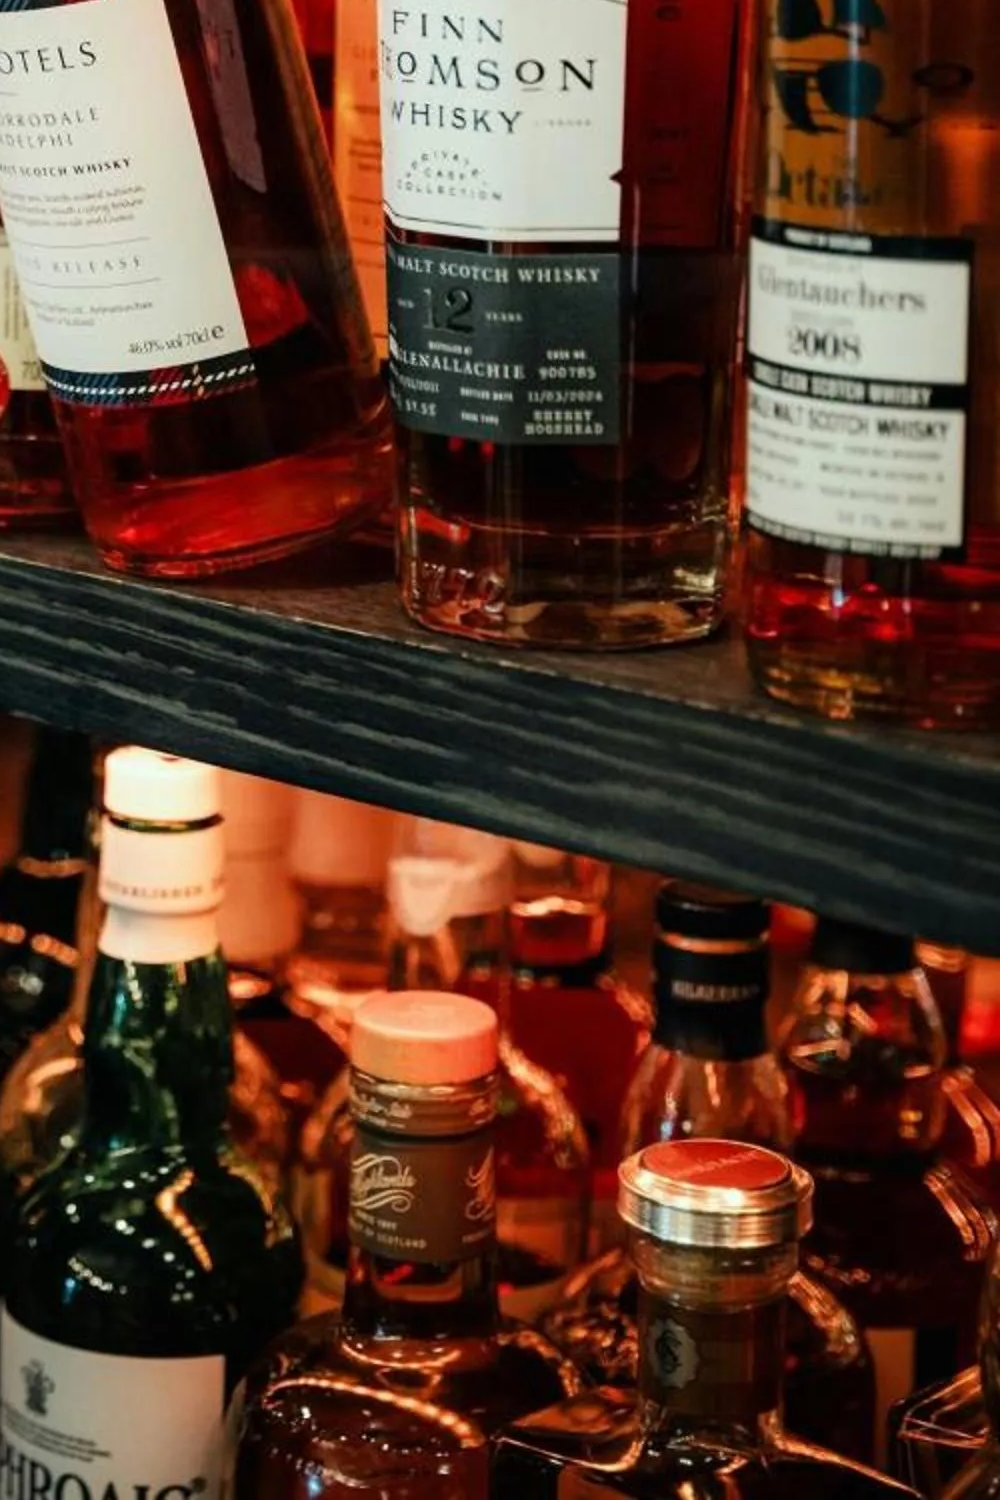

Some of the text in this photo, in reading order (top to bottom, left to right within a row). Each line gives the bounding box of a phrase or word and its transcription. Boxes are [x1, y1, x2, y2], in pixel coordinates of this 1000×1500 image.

[390, 9, 505, 44] FINN
[380, 37, 598, 93] OMSON
[73, 156, 132, 177] WHISKY
[439, 261, 509, 284] SCOTCH
[517, 266, 601, 284] WHISKY
[423, 286, 474, 334] 12
[786, 325, 864, 364] 2008
[876, 418, 951, 444] WHISKY
